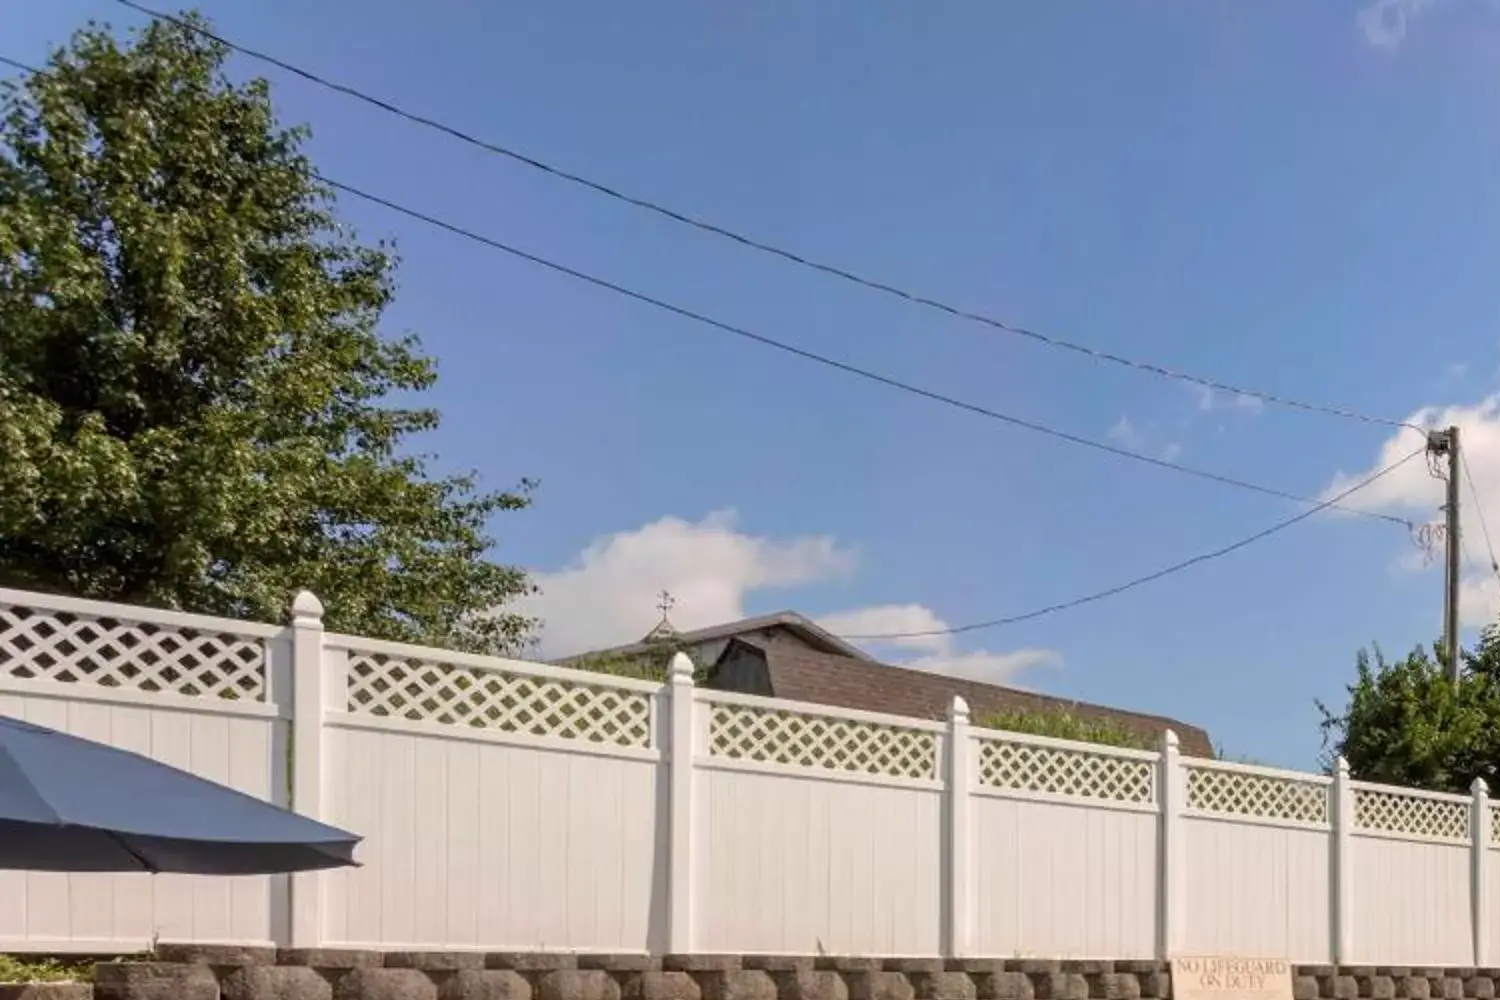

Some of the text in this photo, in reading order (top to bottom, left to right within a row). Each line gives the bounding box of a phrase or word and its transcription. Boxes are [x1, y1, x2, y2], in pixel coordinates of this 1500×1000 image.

[1177, 959, 1287, 975] NO LIFEGUARD
[1199, 975, 1265, 989] ON DUTY
